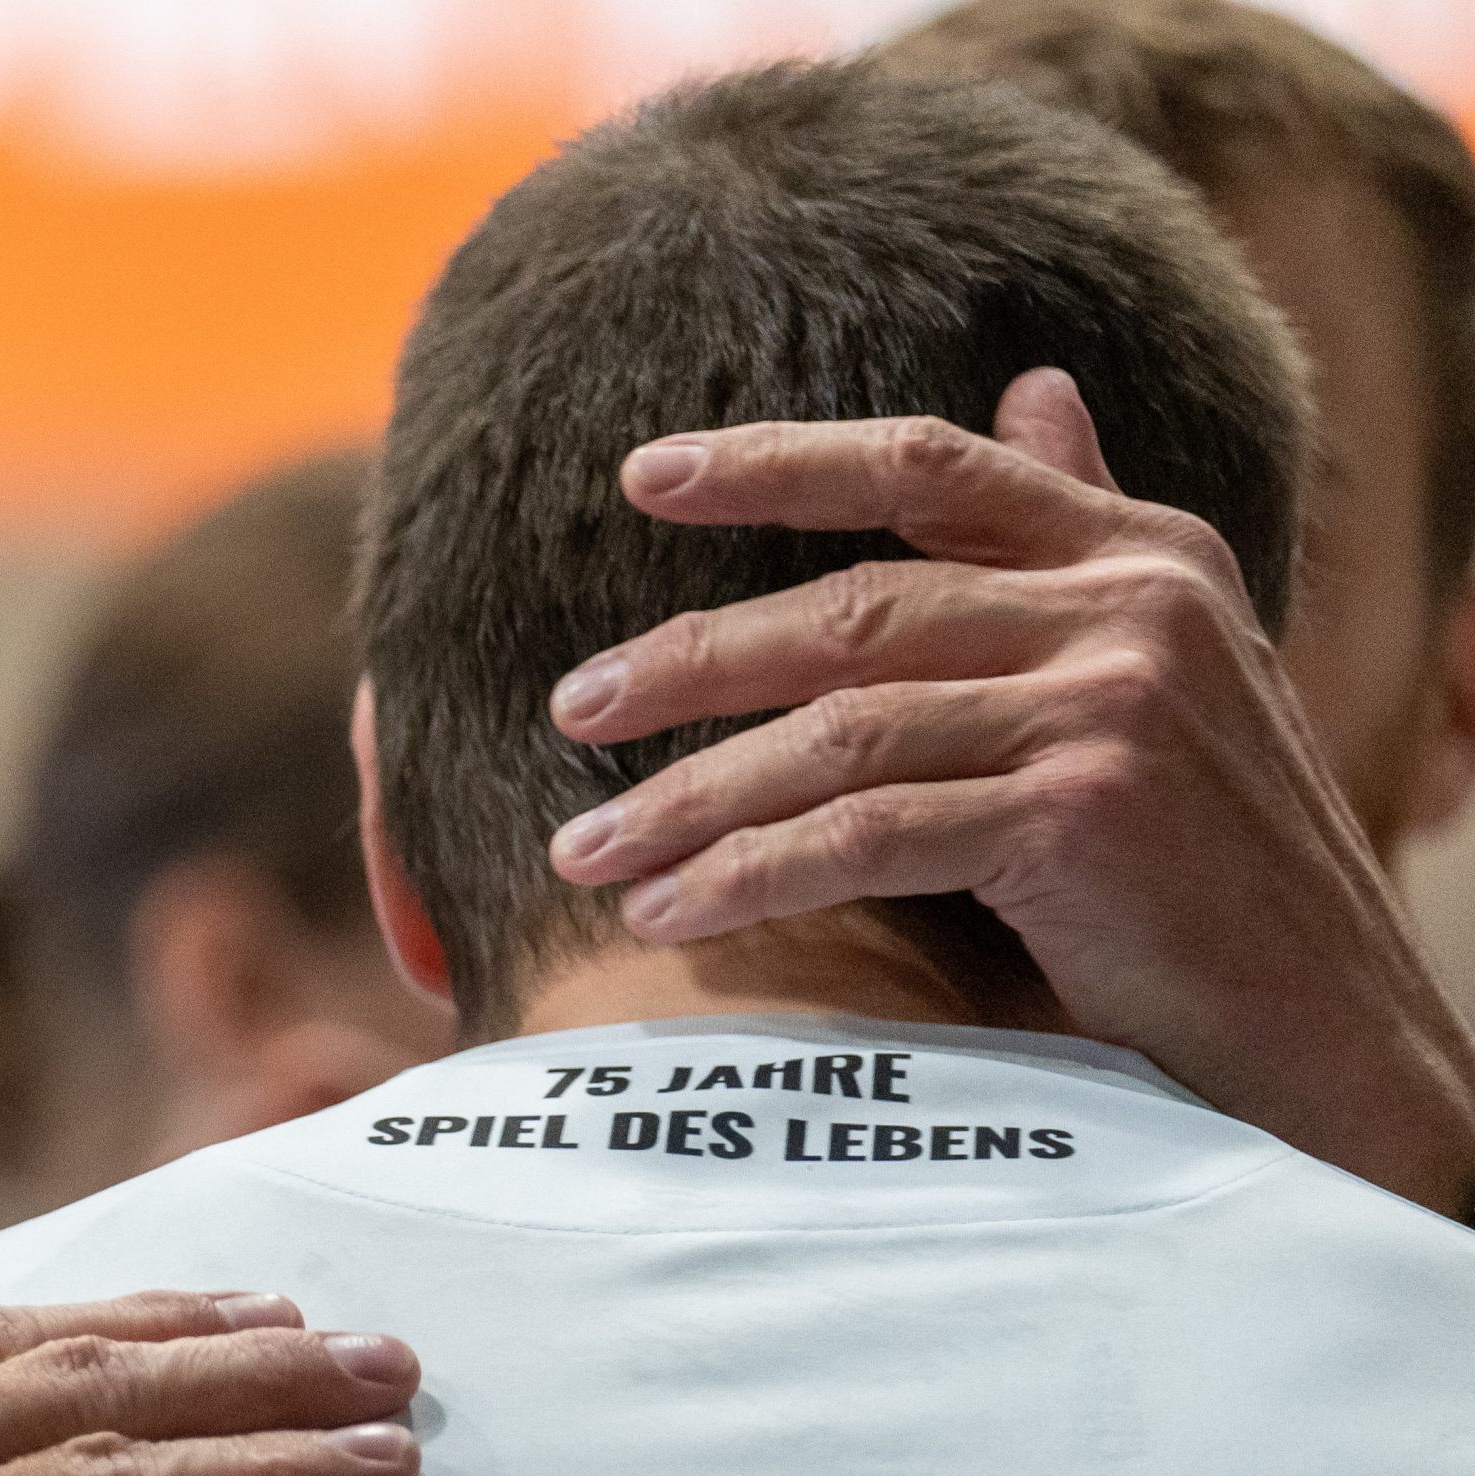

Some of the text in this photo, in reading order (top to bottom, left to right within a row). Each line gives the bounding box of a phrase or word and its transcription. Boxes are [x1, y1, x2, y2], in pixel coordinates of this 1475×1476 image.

[544, 1052, 913, 1104] 75 JAHRE
[366, 1110, 1076, 1162] SPIEL DES LEBENS
